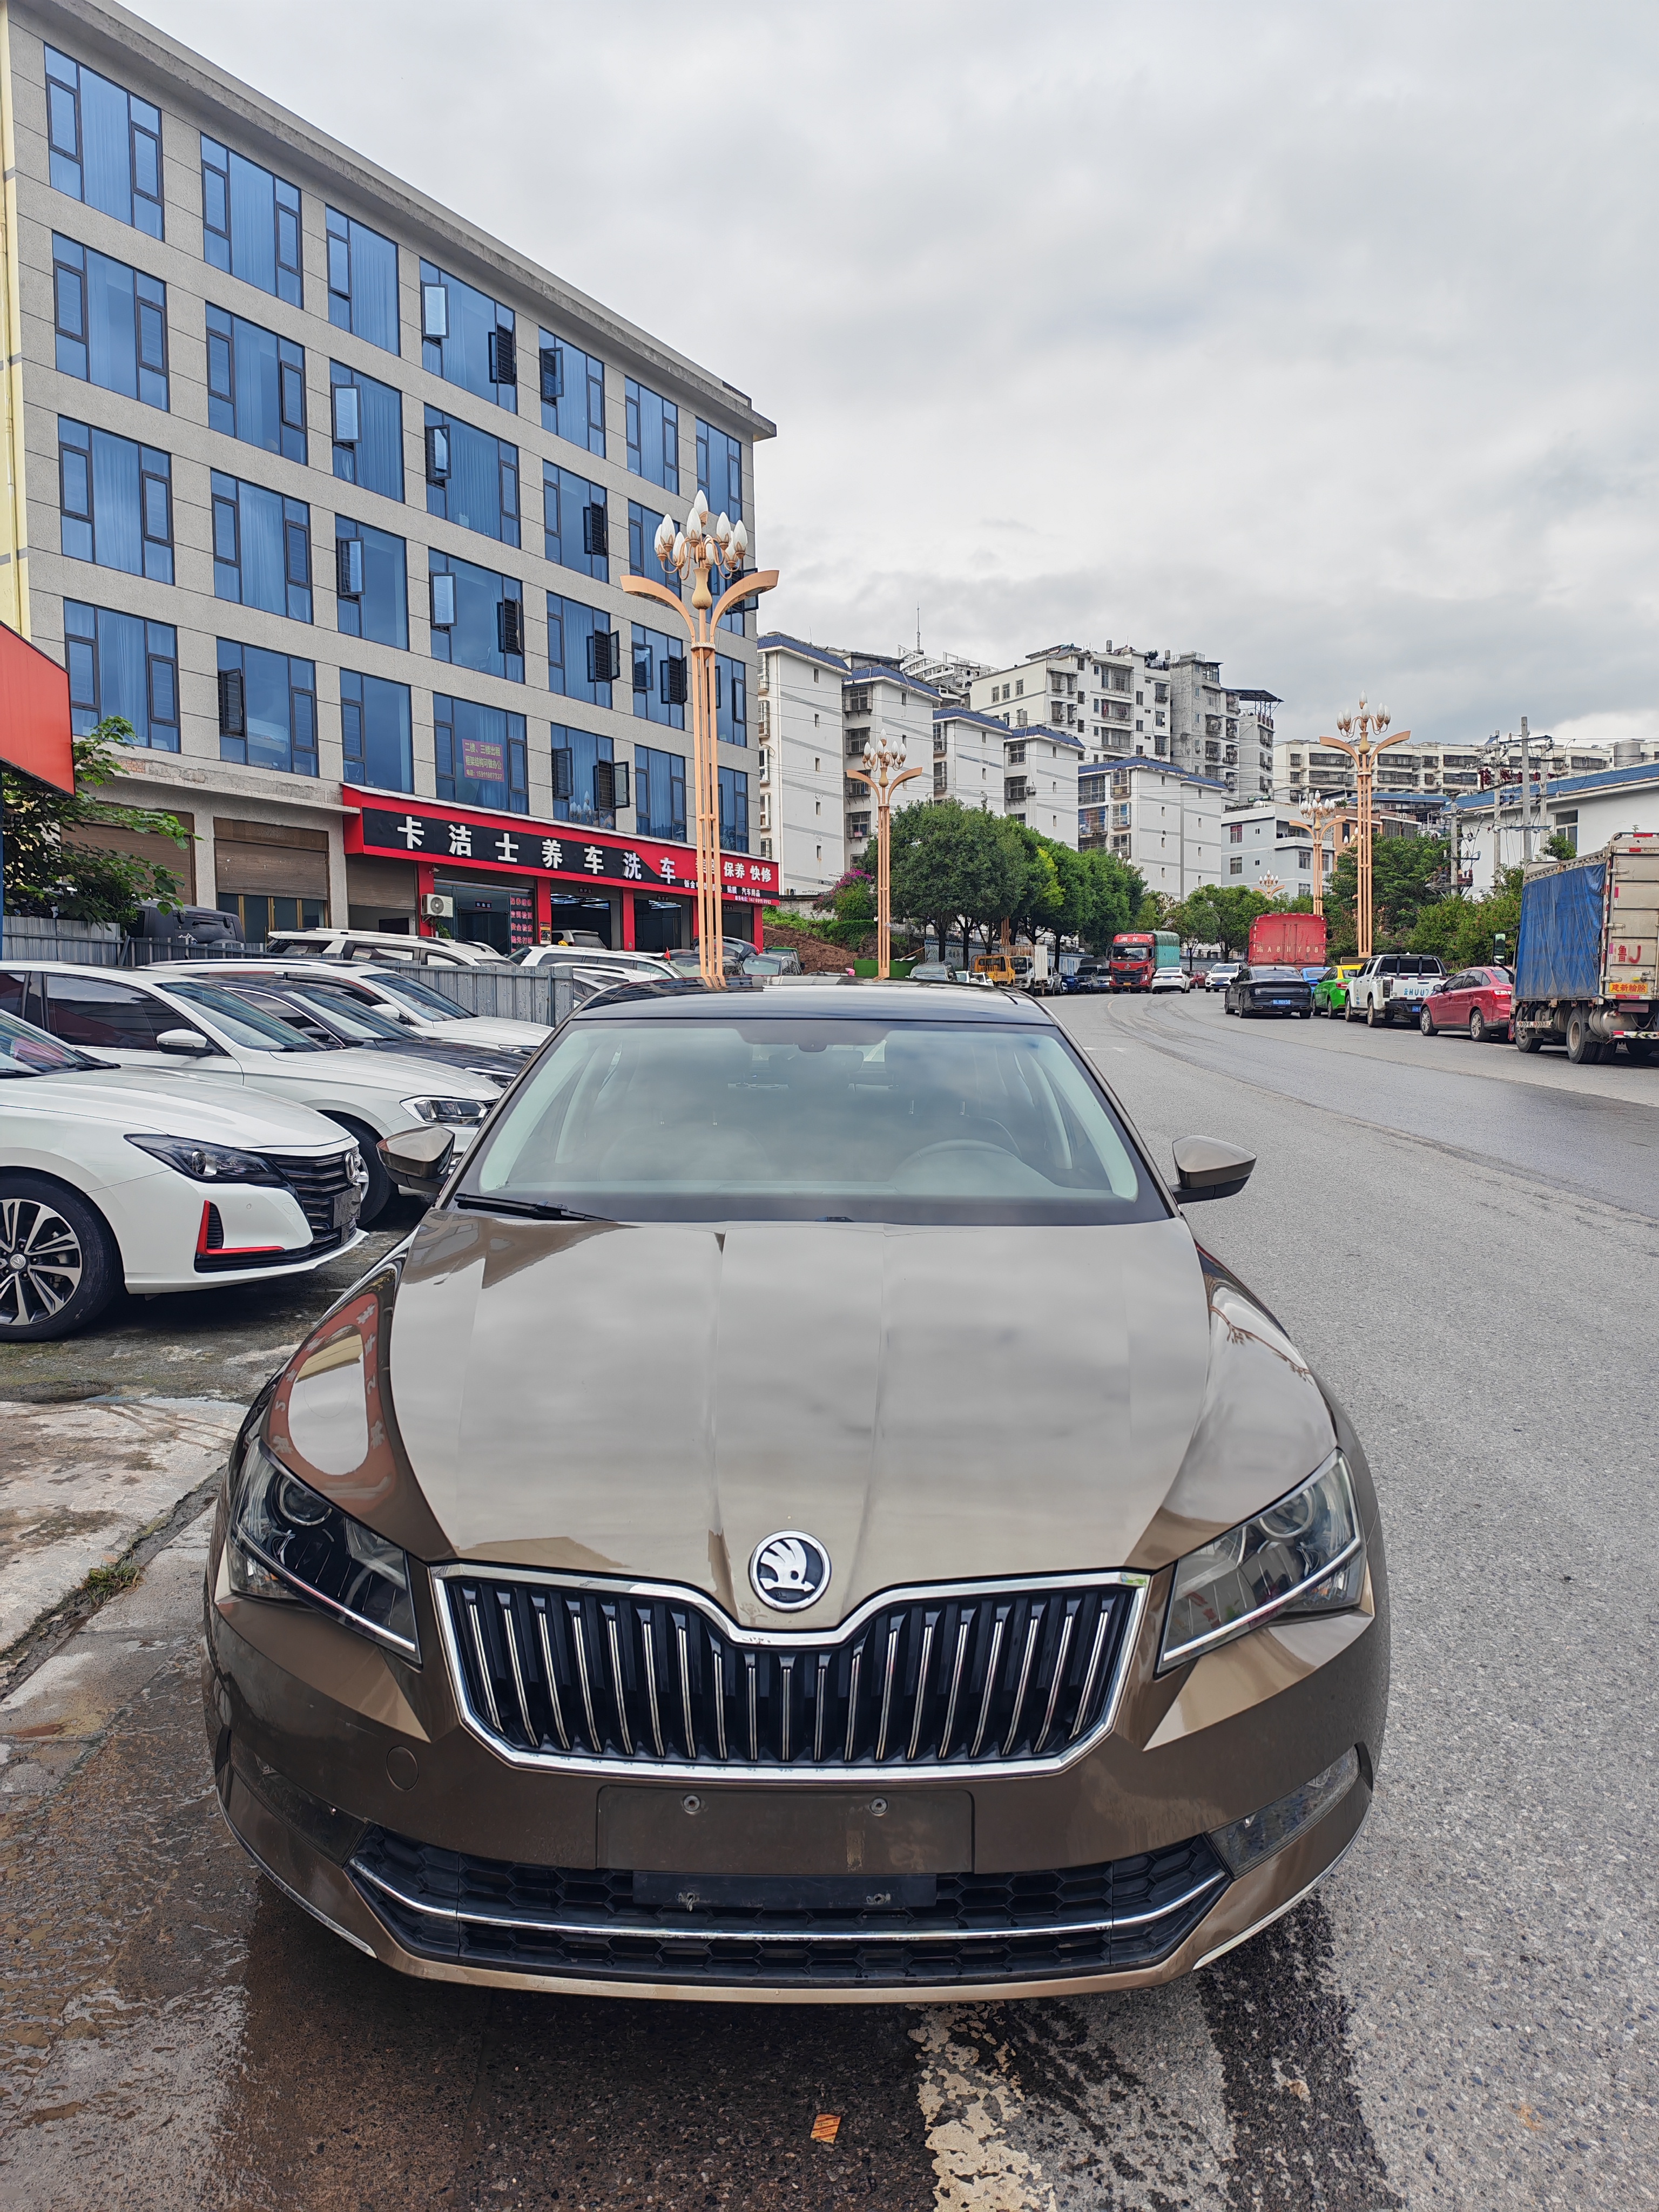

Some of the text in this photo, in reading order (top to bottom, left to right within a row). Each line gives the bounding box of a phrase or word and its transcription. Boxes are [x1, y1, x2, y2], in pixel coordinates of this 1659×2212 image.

[397, 816, 676, 884] 卡洁士养车洗车
[724, 861, 745, 879] 保养
[750, 865, 772, 882] 快修
[741, 887, 760, 897] 汽车用品
